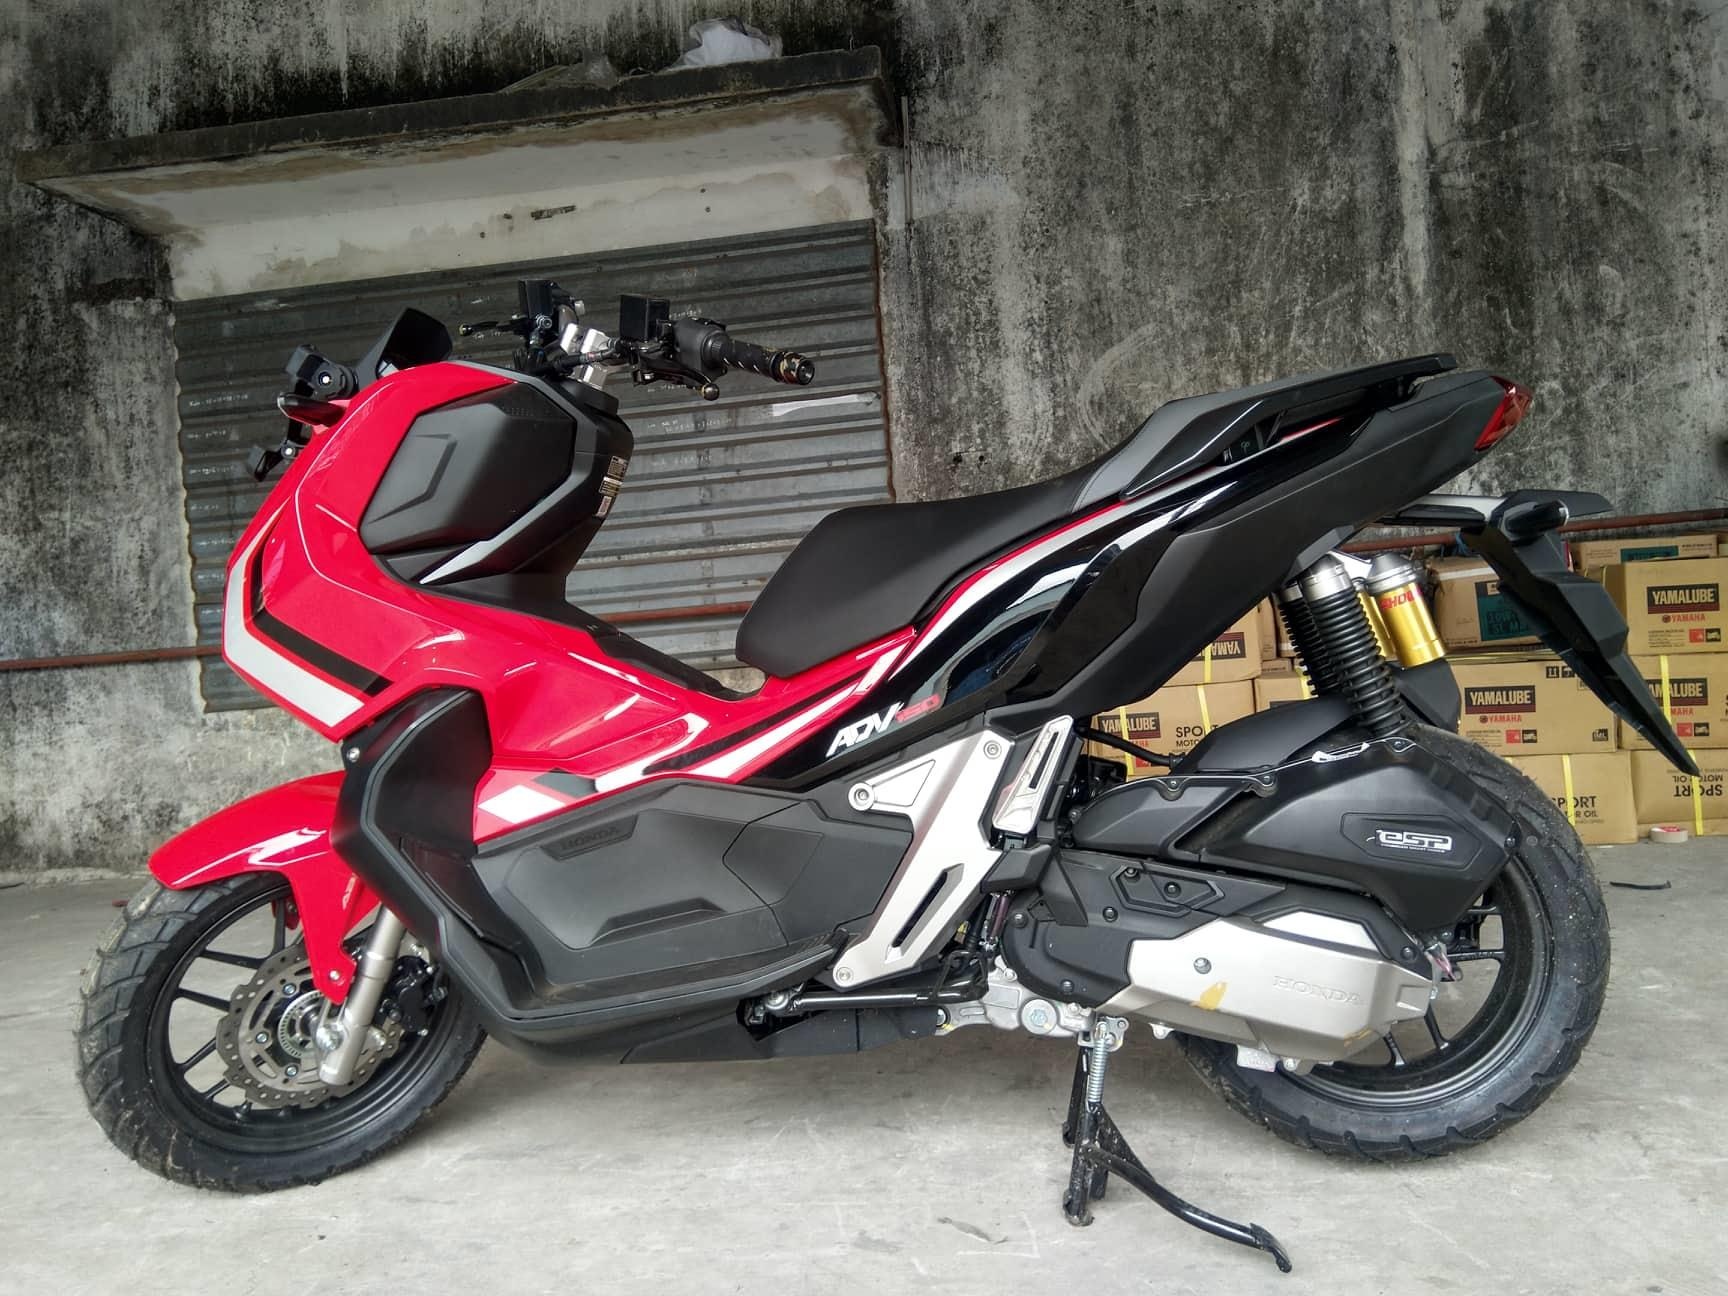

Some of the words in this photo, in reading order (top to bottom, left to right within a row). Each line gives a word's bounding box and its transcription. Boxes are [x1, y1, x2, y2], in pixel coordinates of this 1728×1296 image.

[1652, 588, 1715, 605] YAMALUBE
[1670, 613, 1706, 623] YAMAHA
[1470, 690, 1531, 706] YAMALUBE
[1488, 714, 1522, 723] YAMAHA
[1272, 975, 1363, 1005] HONDA
